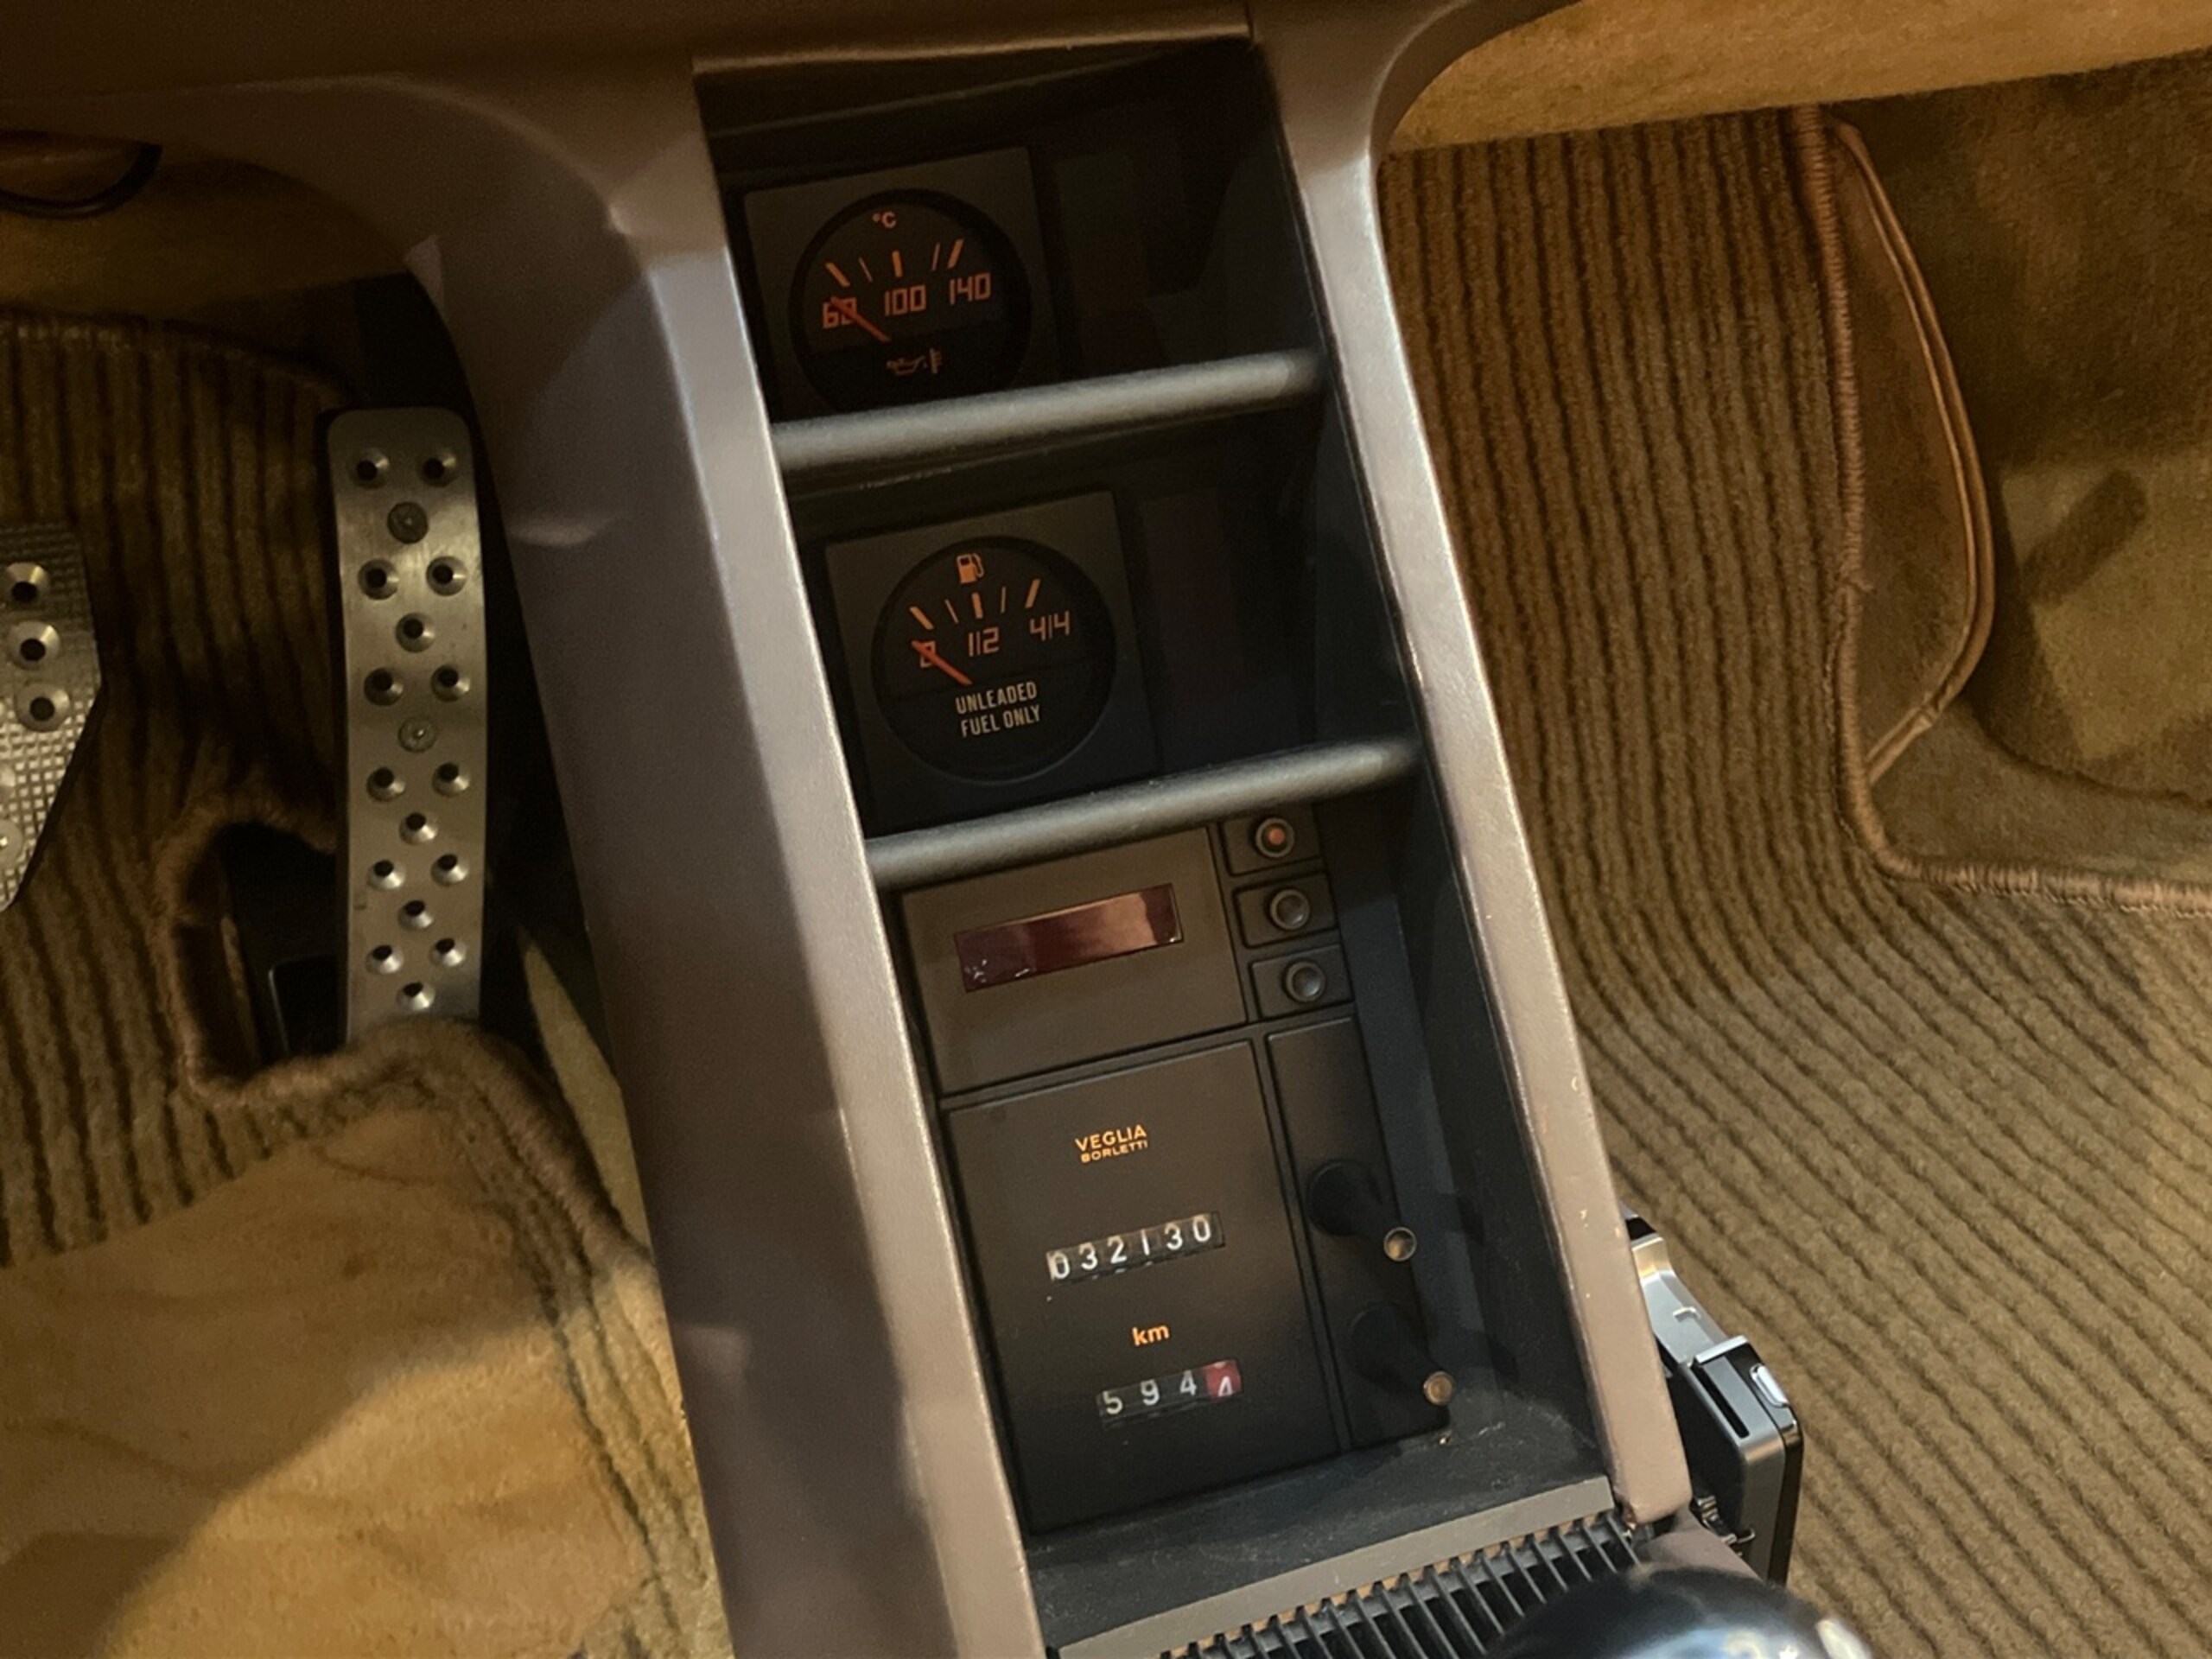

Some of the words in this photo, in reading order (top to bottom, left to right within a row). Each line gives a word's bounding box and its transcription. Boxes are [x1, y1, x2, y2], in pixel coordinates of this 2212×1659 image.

[885, 285, 926, 316] 100
[950, 272, 991, 305] 140
[955, 681, 1037, 714] UNLEADED
[961, 714, 1001, 737] FUEL
[1003, 704, 1040, 728] ONLY
[1075, 1124, 1147, 1152] VEGLIA
[1080, 1140, 1148, 1163] BORLETTI
[1050, 1214, 1211, 1279] 032130
[1132, 1325, 1170, 1346] km
